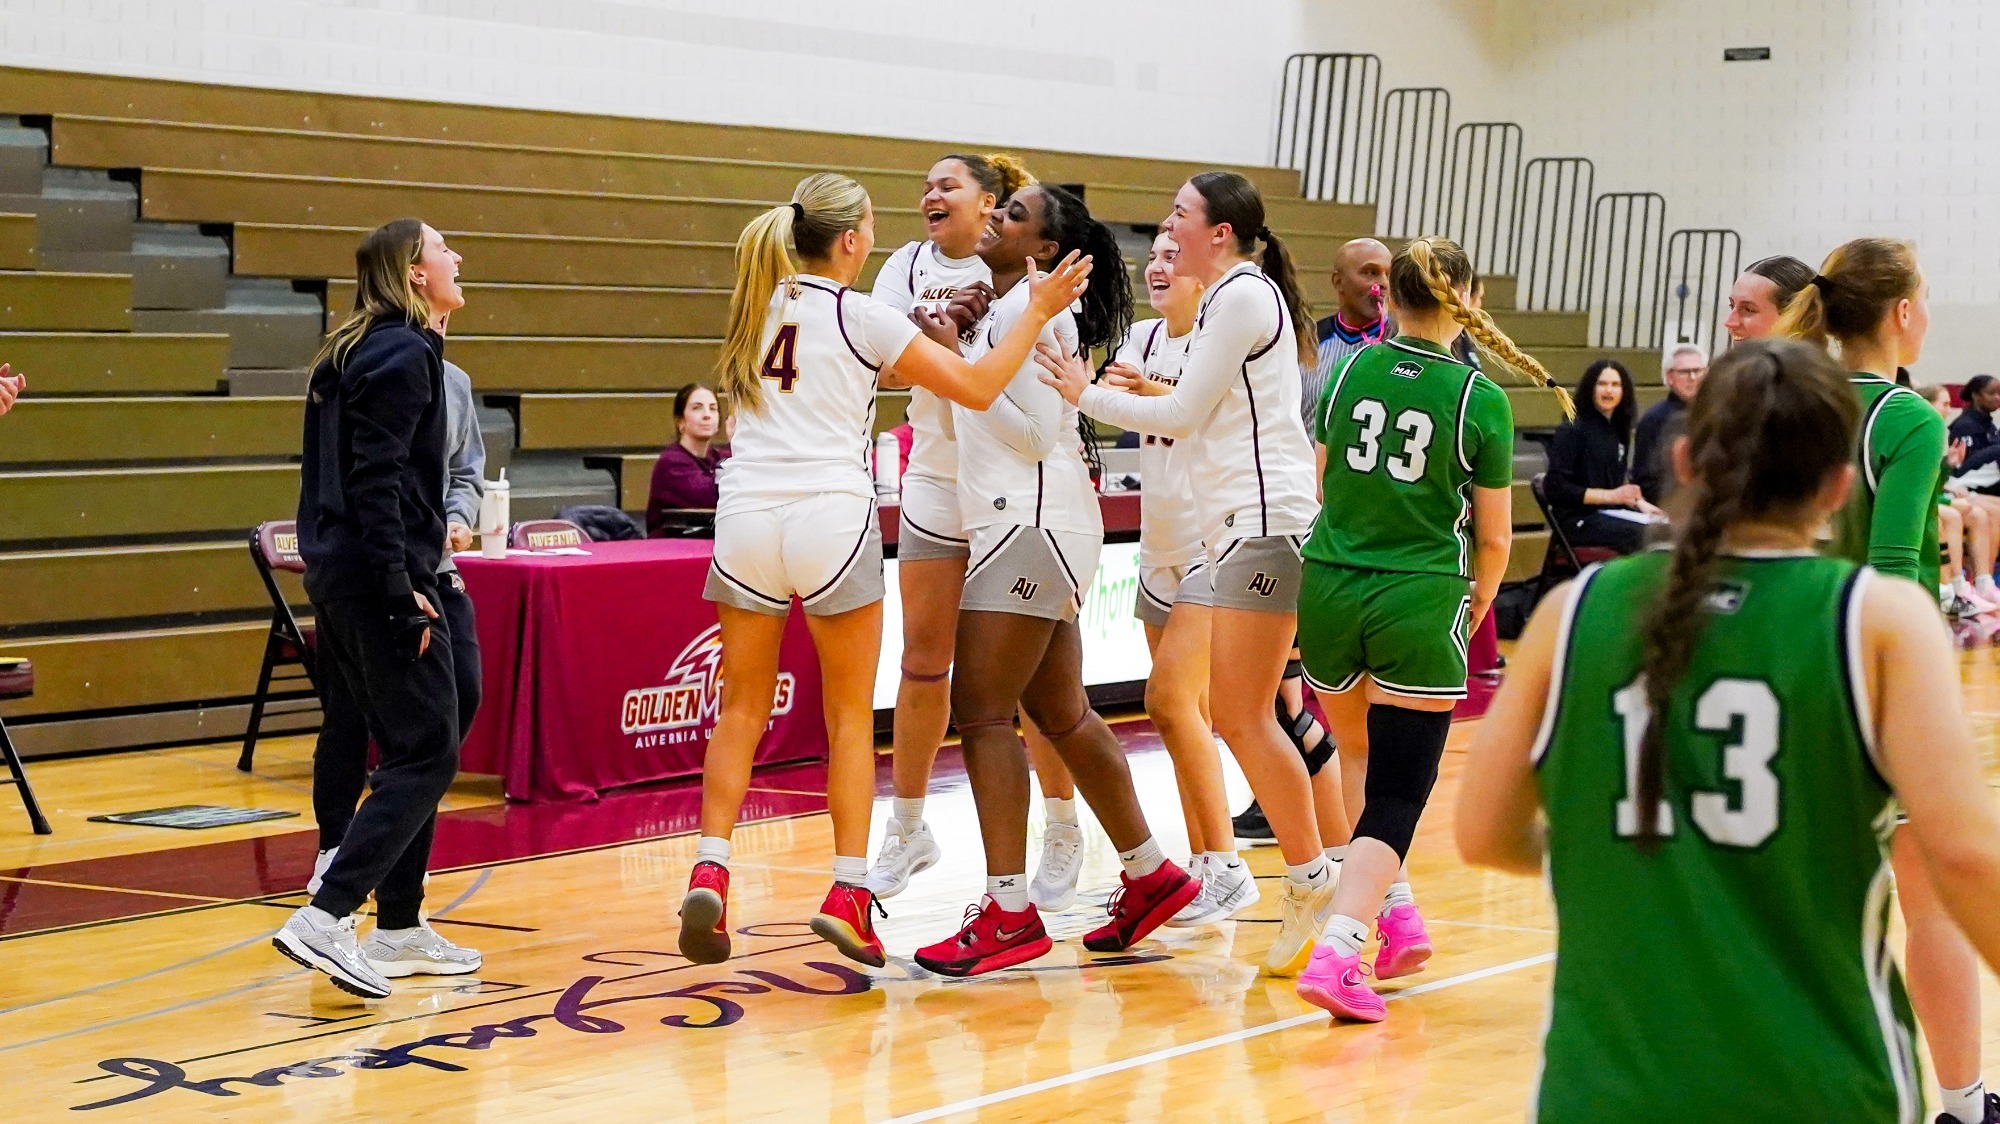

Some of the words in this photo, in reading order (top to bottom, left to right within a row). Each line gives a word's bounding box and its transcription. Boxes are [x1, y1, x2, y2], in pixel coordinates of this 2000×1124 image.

[920, 288, 958, 300] ALVE
[761, 323, 799, 392] 4
[1394, 367, 1418, 377] MAC
[1346, 398, 1435, 484] 33
[276, 536, 298, 550] ALVE
[1009, 577, 1038, 600] AU
[1248, 572, 1277, 596] AU
[624, 687, 702, 729] GOLDEN
[635, 731, 698, 749] ALVERNIA
[1614, 677, 1780, 848] 13
